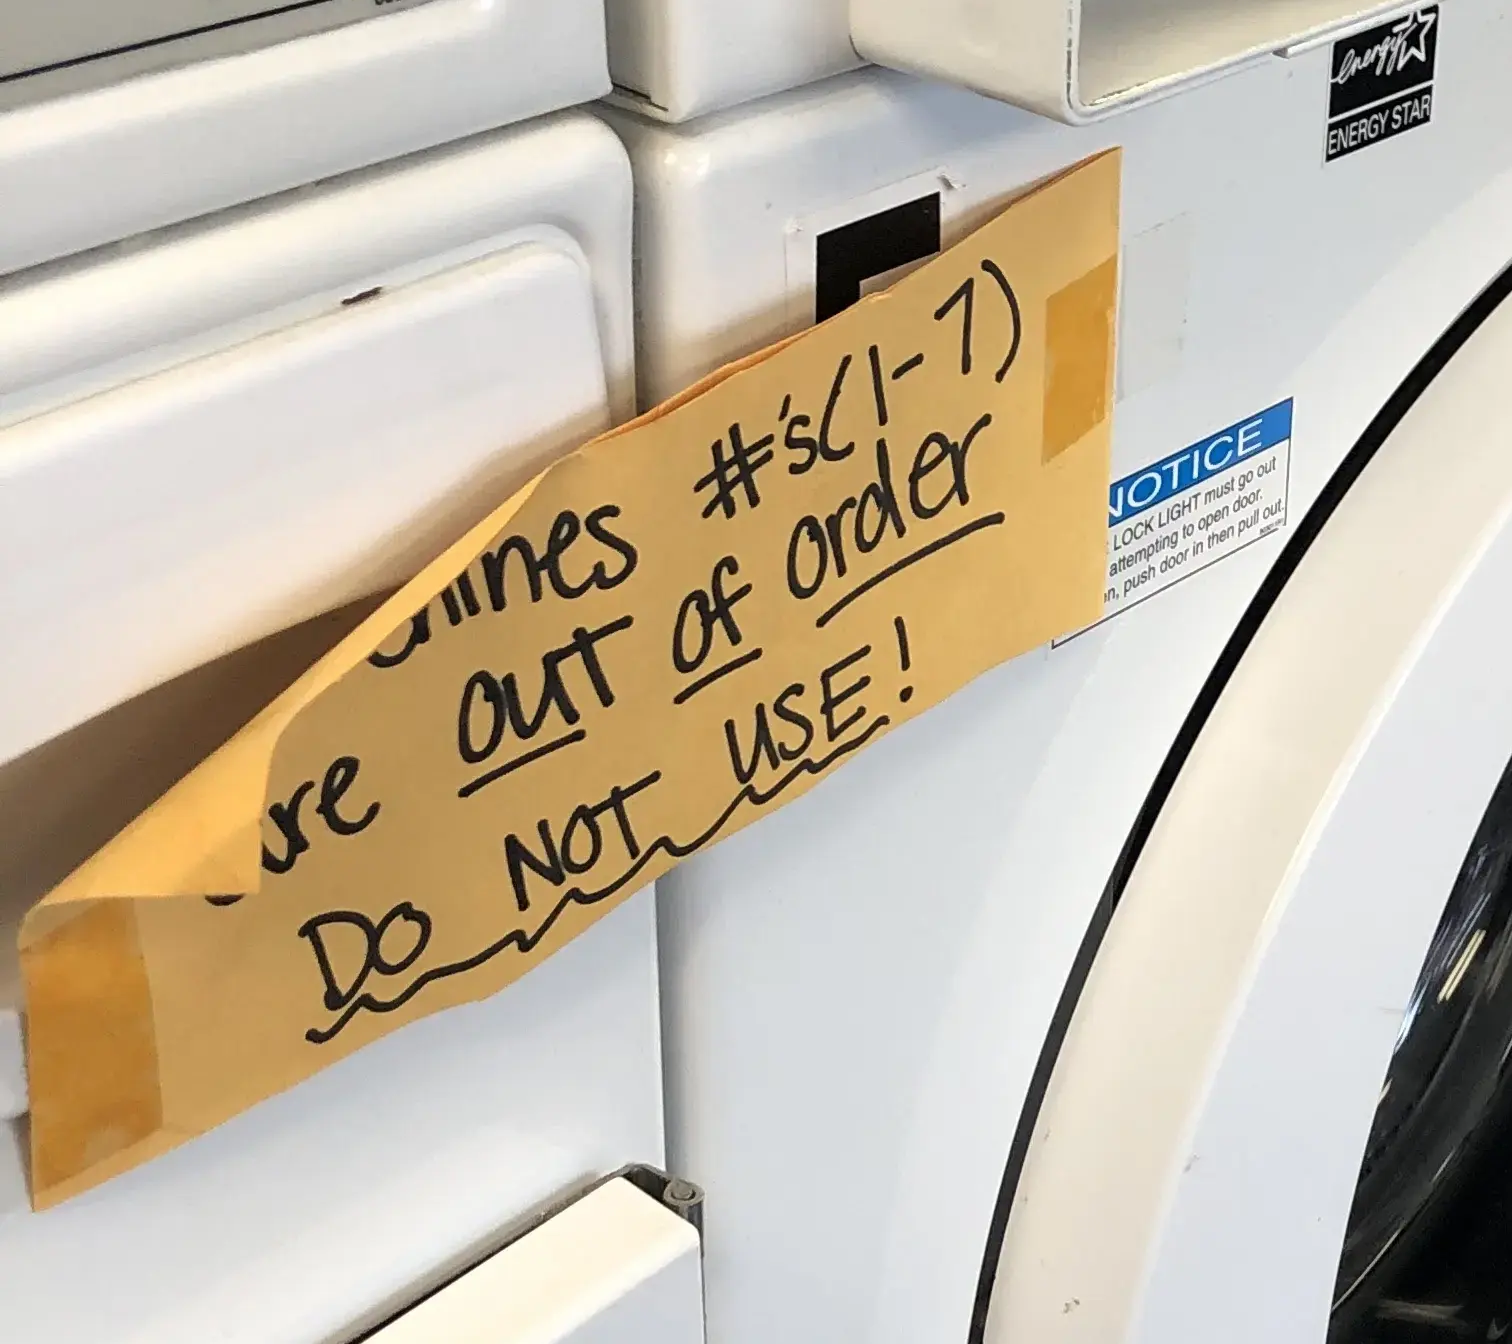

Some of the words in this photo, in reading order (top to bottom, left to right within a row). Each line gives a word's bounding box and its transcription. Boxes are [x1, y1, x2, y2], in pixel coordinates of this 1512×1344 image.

[1327, 109, 1390, 156] ENERGY
[1390, 93, 1432, 130] STAR
[1108, 526, 1180, 578] attempting
[1181, 521, 1196, 541] to
[1199, 504, 1230, 533] open
[1232, 487, 1264, 514] door.
[1112, 514, 1156, 552] LOCK
[1157, 491, 1202, 529] LIGHT
[1204, 479, 1236, 506] must
[1238, 469, 1255, 493] go
[1256, 455, 1278, 479] out
[1122, 563, 1157, 598] push
[1159, 546, 1191, 574] door
[1192, 540, 1205, 558] in
[1207, 525, 1236, 550] then
[1237, 509, 1261, 542] pull
[1262, 497, 1286, 520] out.
[297, 900, 433, 1013] DO
[503, 768, 663, 913] NOT
